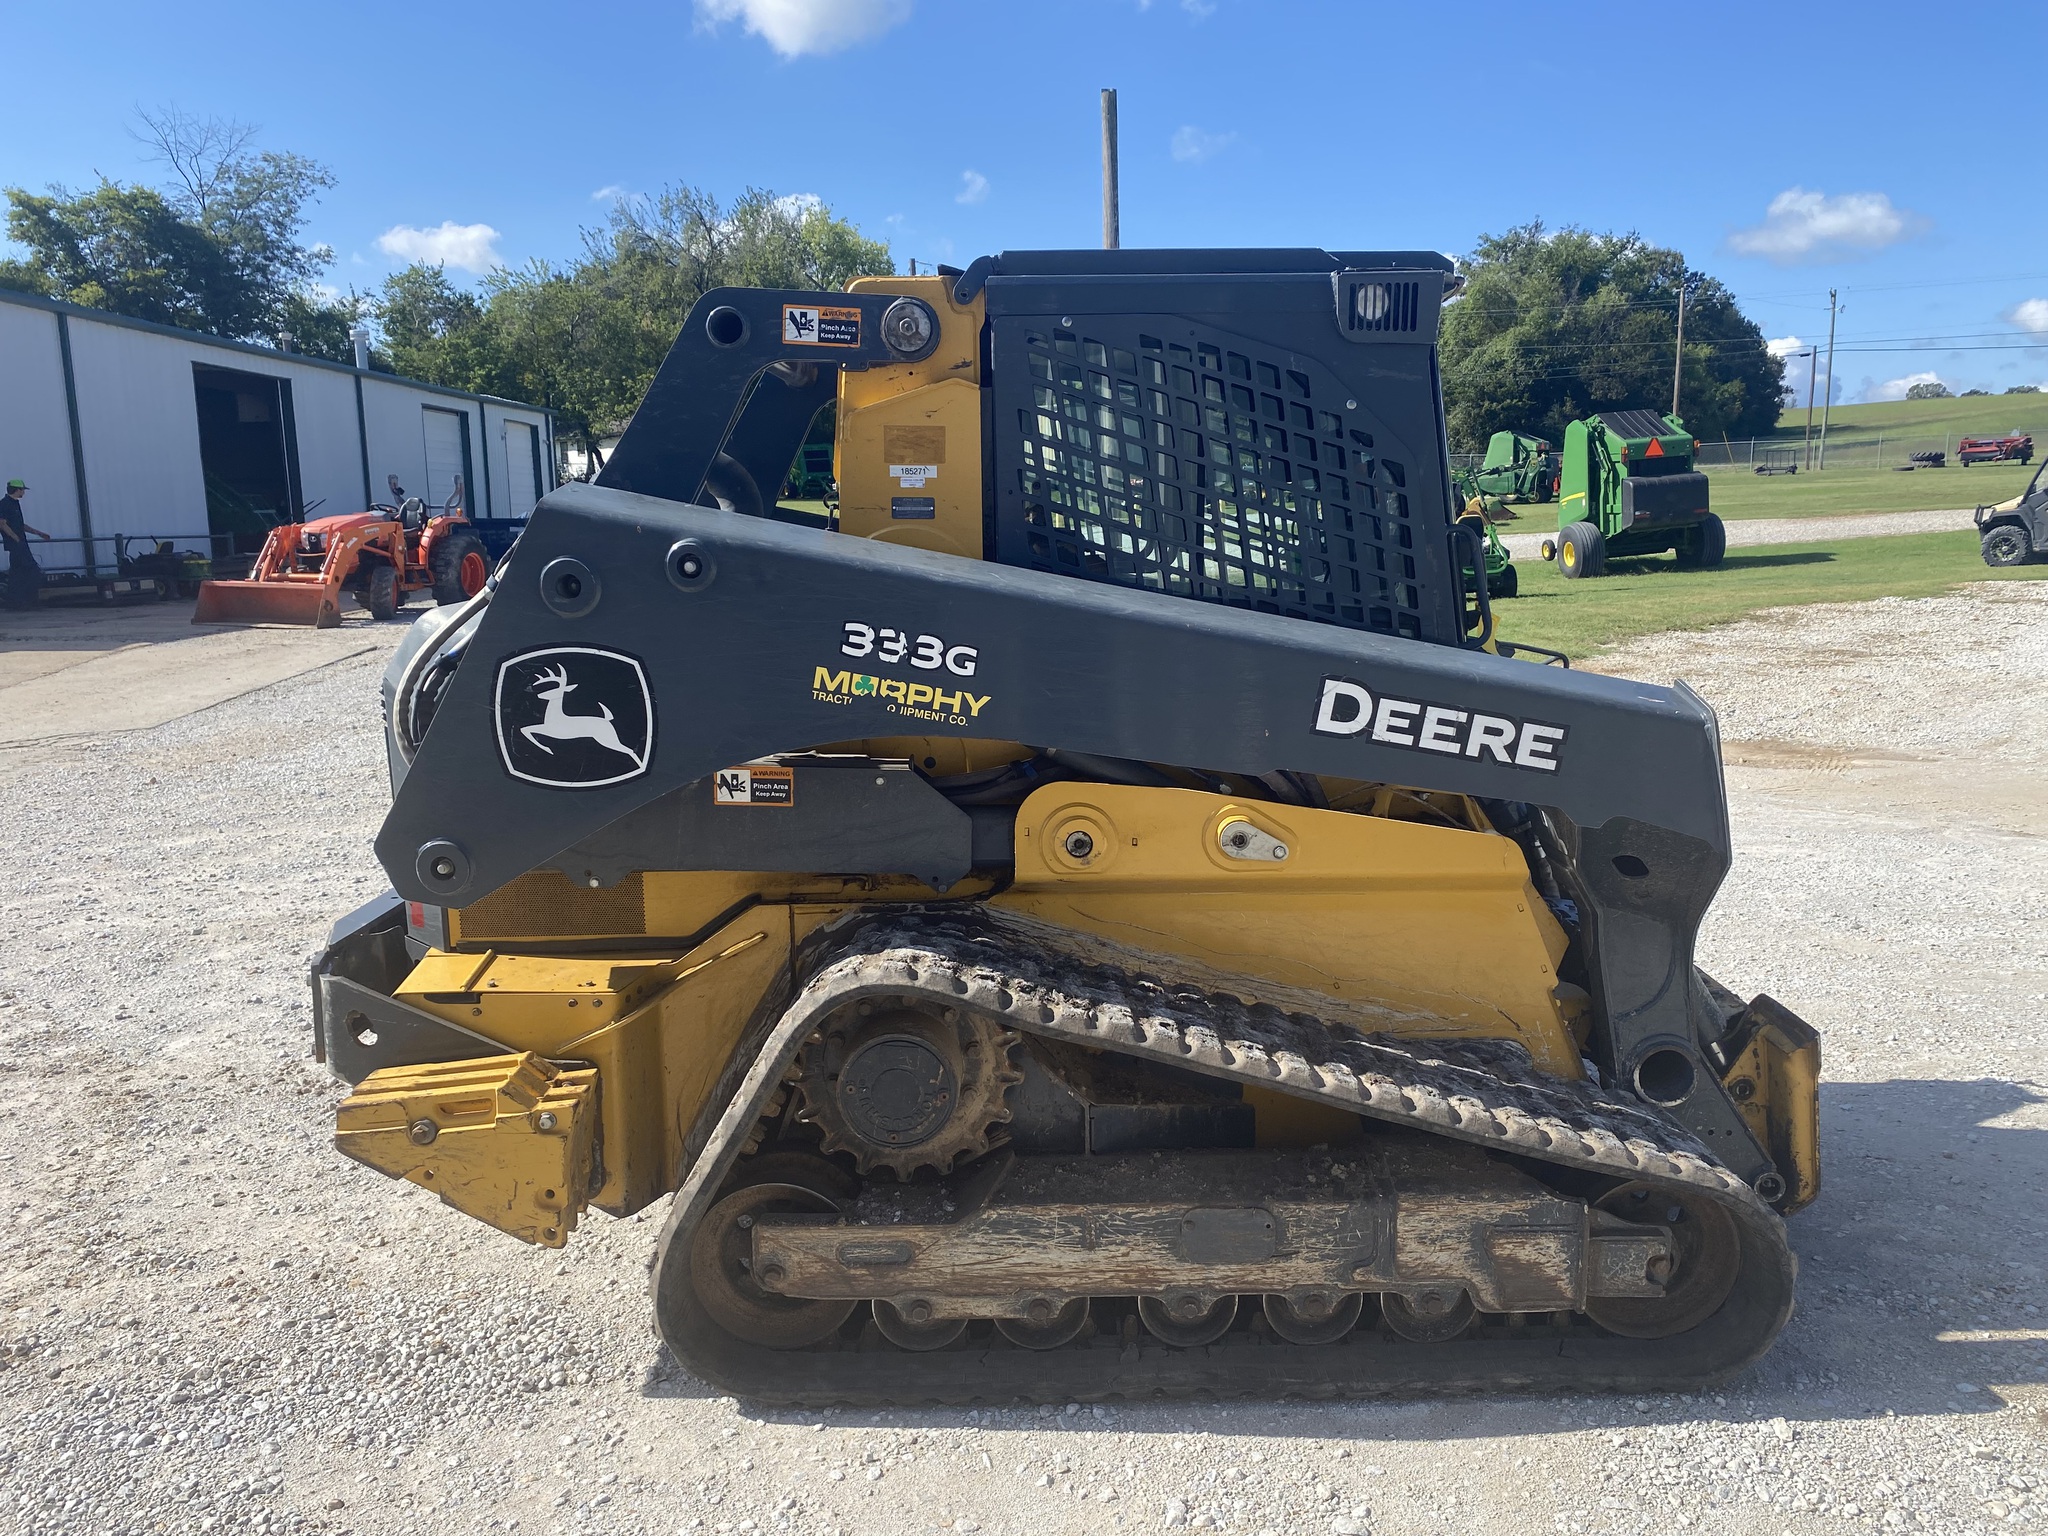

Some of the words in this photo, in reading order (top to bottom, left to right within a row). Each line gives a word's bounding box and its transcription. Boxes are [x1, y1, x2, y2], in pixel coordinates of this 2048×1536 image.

[828, 310, 857, 318] WARNG
[820, 332, 835, 340] Keep
[836, 333, 851, 341] Away
[901, 467, 926, 476] 185271
[841, 622, 978, 676] 333G
[813, 666, 991, 717] MURPHY
[812, 690, 853, 706] TRACT
[886, 704, 947, 722] QIPMENT
[949, 714, 969, 727] CO.
[1315, 678, 1565, 771] DEERE
[753, 782, 772, 790] Pinch
